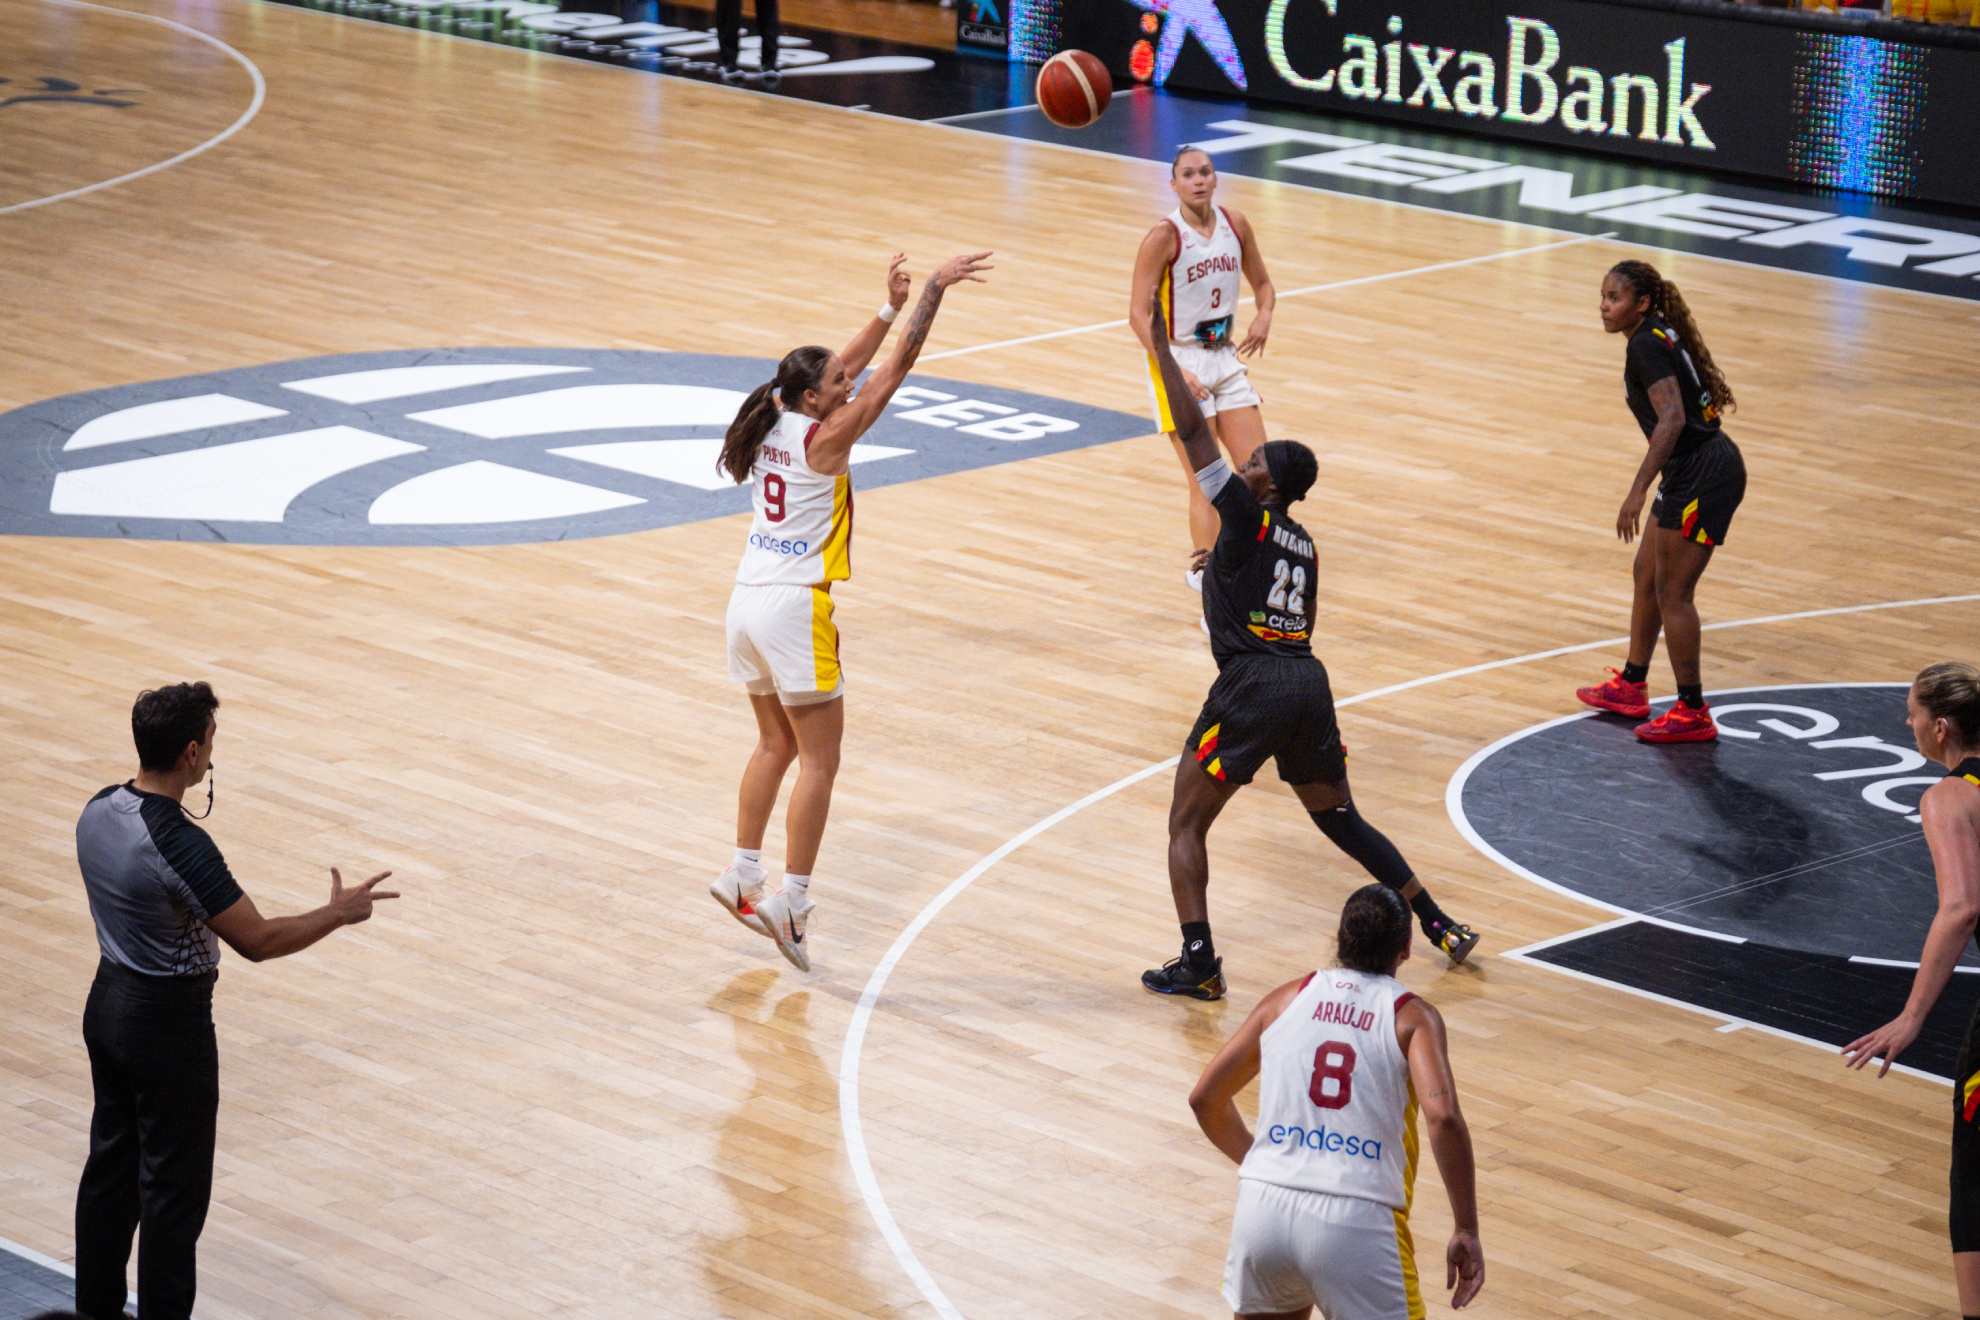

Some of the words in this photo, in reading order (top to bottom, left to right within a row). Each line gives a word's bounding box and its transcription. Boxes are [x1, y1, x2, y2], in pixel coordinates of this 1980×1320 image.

[1264, 0, 1717, 151] CaixaBank
[1187, 253, 1239, 284] ESPAÑA
[1211, 287, 1222, 309] 3
[763, 444, 791, 467] PUEYO
[763, 472, 787, 523] 9
[1267, 558, 1307, 615] 22
[1312, 1001, 1375, 1032] ARAÚJO
[1308, 1039, 1357, 1111] 8
[1269, 1124, 1382, 1161] endesa
